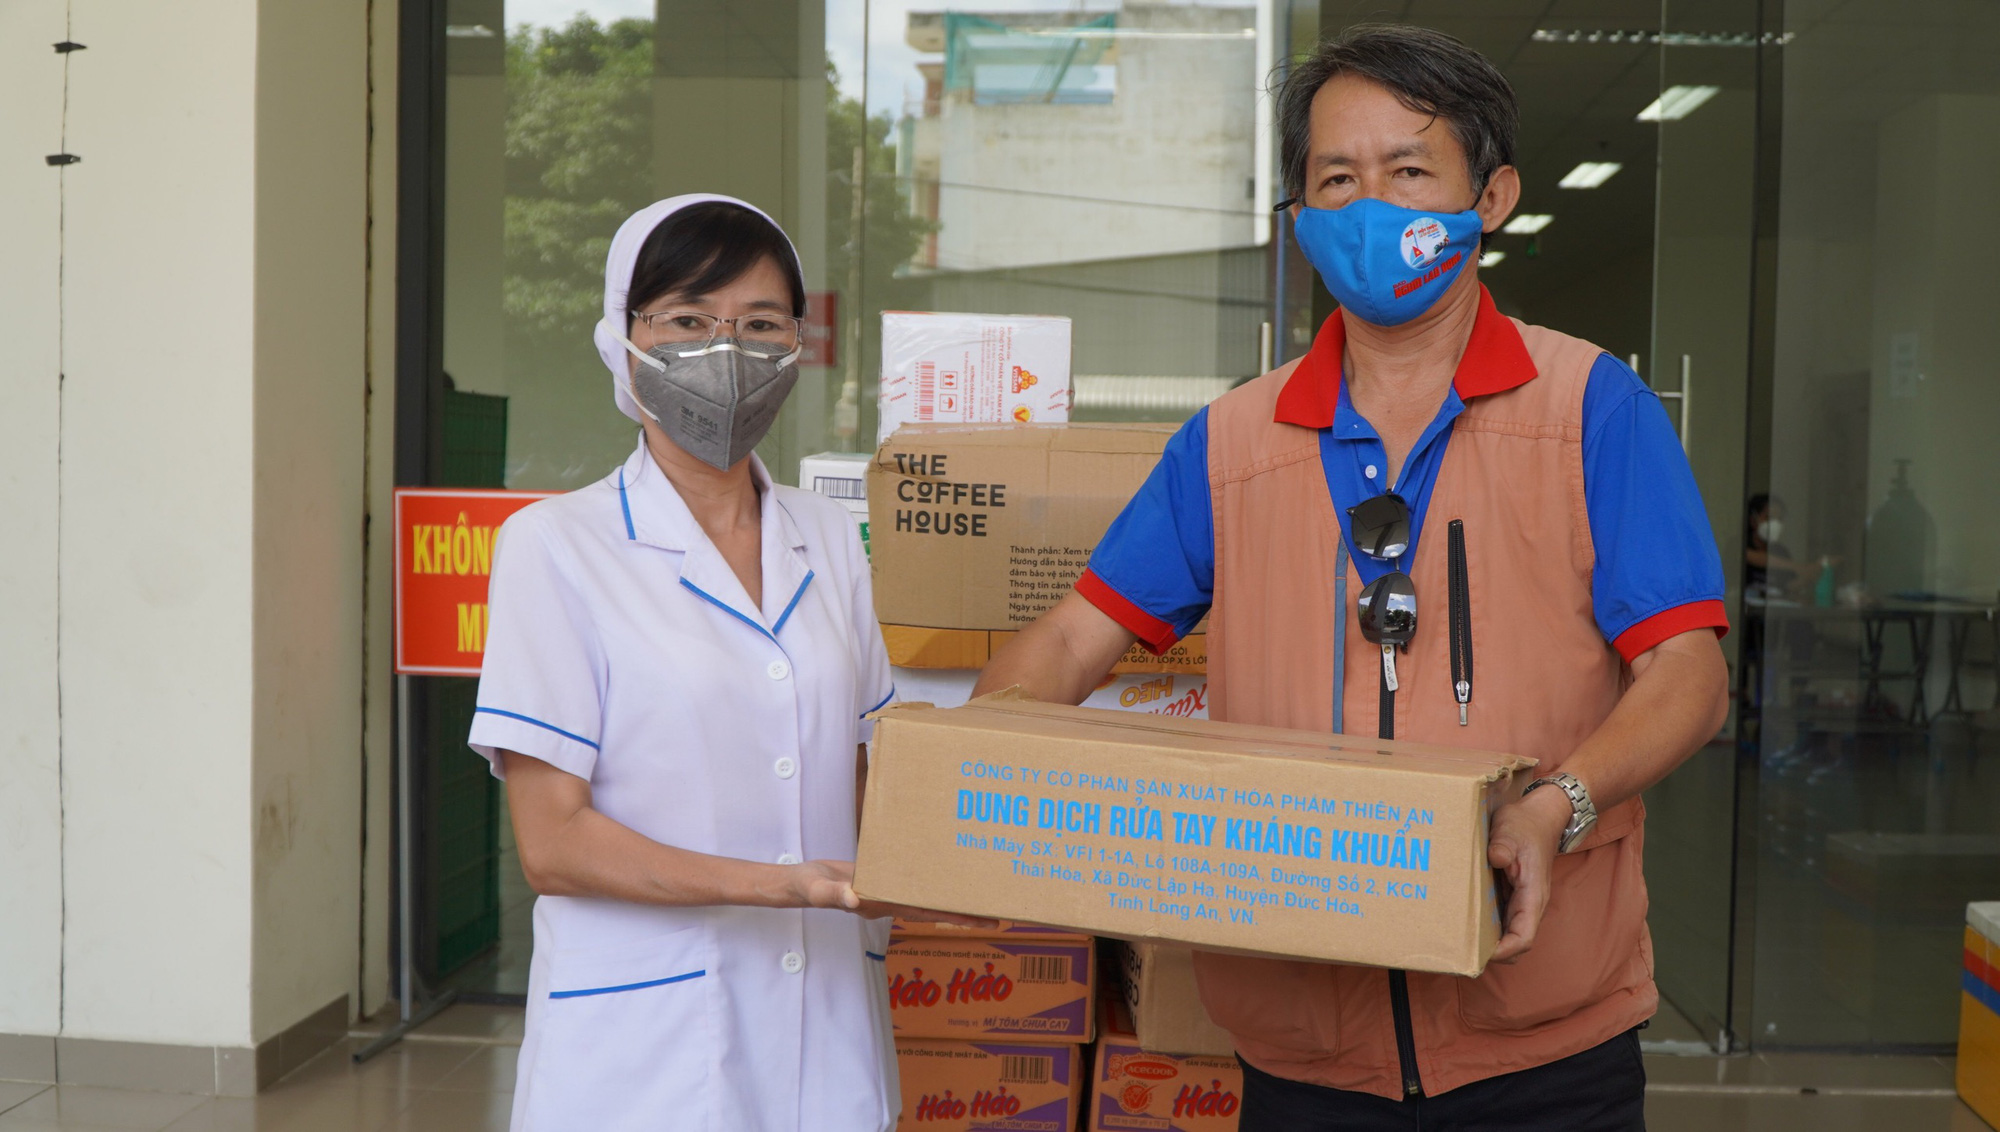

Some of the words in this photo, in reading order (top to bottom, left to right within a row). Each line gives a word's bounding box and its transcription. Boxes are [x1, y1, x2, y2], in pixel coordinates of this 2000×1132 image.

[681, 405, 694, 419] 3M
[697, 414, 718, 431] 9541
[893, 453, 947, 476] THE
[897, 479, 1006, 507] COFFEE
[896, 509, 988, 537] HOUSE
[1010, 546, 1035, 555] Thành
[1063, 547, 1082, 555] Xem
[1009, 580, 1035, 590] Thông
[1051, 581, 1071, 589] cảnh
[1029, 569, 1045, 577] bảo
[1047, 571, 1057, 579] vệ
[1058, 570, 1078, 579] sinh,
[1009, 603, 1030, 612] Ngày
[1025, 592, 1048, 601] phẩm
[1119, 675, 1174, 707] HEO
[961, 759, 1013, 781] CÔNG
[1020, 767, 1041, 784] TY
[1406, 808, 1435, 825] AN
[956, 789, 1030, 827] DUNG
[1037, 797, 1101, 838] DỊCH
[1109, 796, 1164, 841] RỬA
[1172, 811, 1218, 847] TAY
[1225, 815, 1323, 860] KHÁNG
[1331, 823, 1432, 872] KHUẨN
[956, 832, 988, 850] Nhà
[993, 836, 1026, 858] Máy
[1030, 841, 1059, 858] SX:
[1065, 844, 1093, 862] VFI
[1099, 848, 1140, 869] 1-1A,
[1145, 853, 1166, 871] Lô
[1171, 856, 1265, 882] 108A-109A,
[1271, 867, 1332, 893] Đường
[1336, 873, 1360, 894] Số
[1365, 878, 1381, 897] 2,
[1387, 881, 1428, 901] KCN
[1011, 859, 1045, 878] Thái
[1091, 869, 1113, 886] Xã
[1118, 871, 1152, 890] Đức
[1157, 876, 1188, 897] Lập
[1192, 880, 1219, 902] Hạ,
[1225, 884, 1280, 908] Huyện
[1284, 891, 1320, 910] Đức
[1325, 896, 1365, 918] Hòa,
[1149, 898, 1191, 921] Long
[1194, 903, 1223, 923] An,
[1228, 907, 1258, 926] VN.
[920, 949, 931, 957] VỚI
[932, 949, 951, 958] CÔNG
[946, 962, 1013, 1005] Hảo
[999, 1017, 1019, 1028] TÔM
[1022, 1019, 1048, 1030] CHUA
[1049, 1020, 1068, 1031] CAY
[915, 1049, 934, 1058] CÔNG
[916, 1090, 966, 1121] Hảo
[970, 1086, 1020, 1117] Hảo
[1172, 1079, 1239, 1119] Hảo
